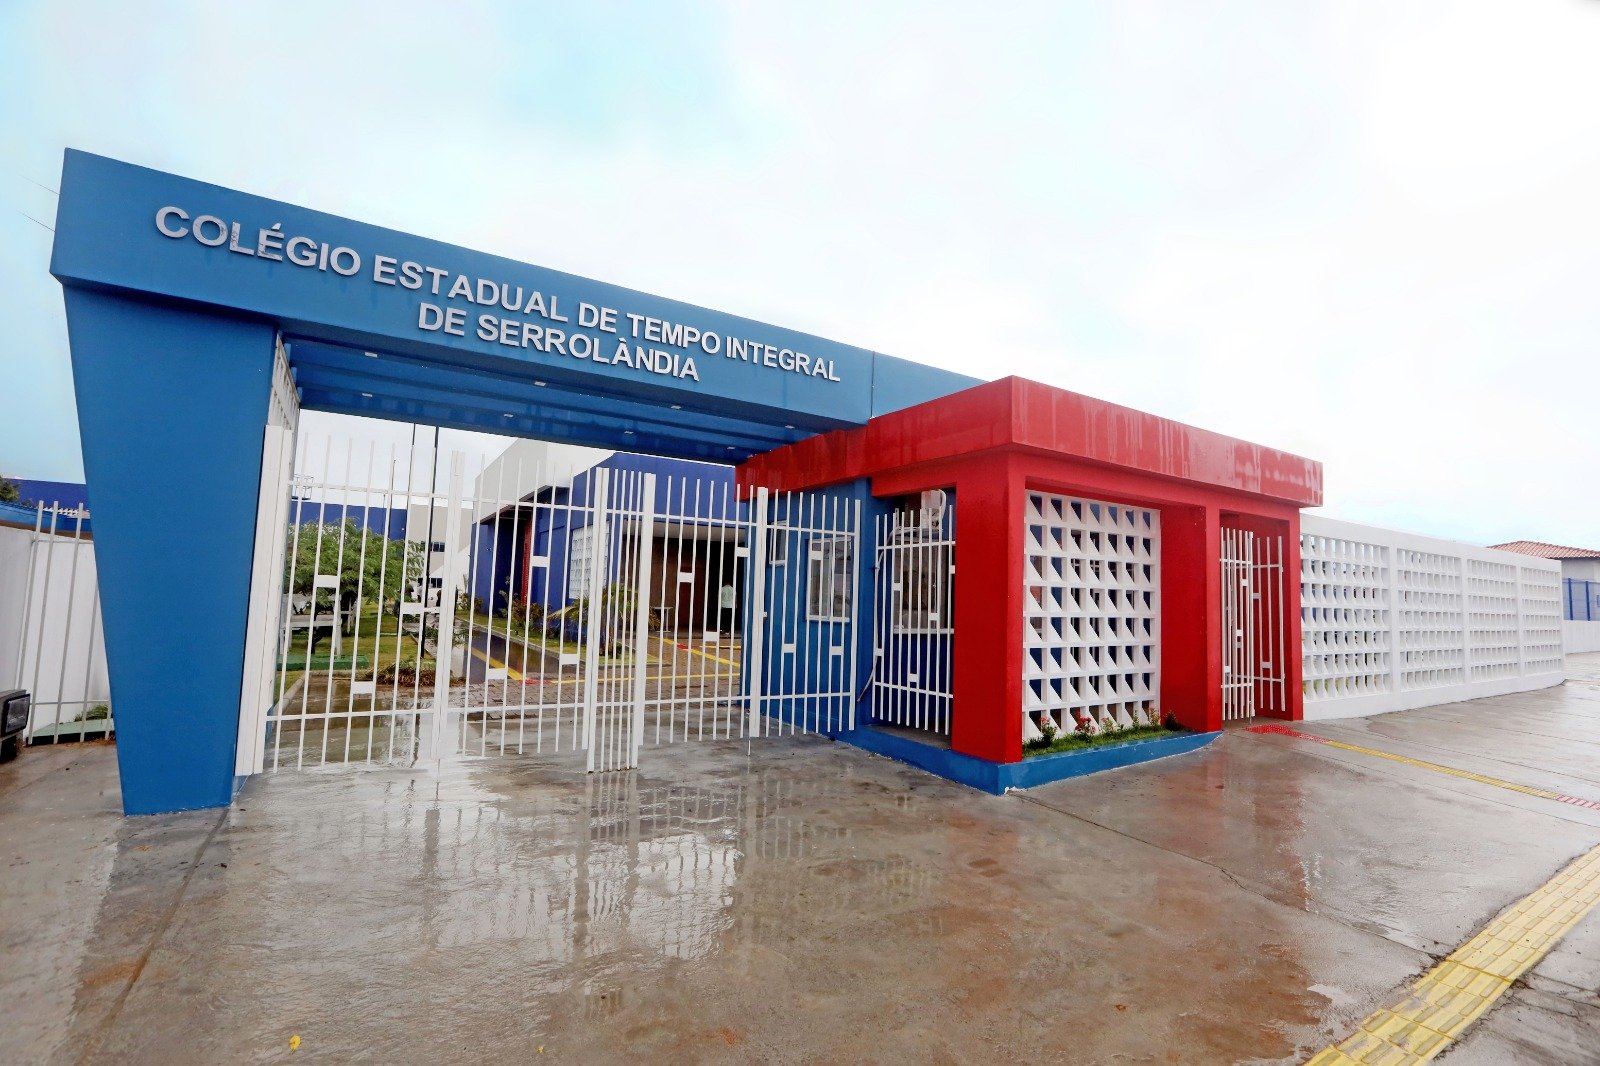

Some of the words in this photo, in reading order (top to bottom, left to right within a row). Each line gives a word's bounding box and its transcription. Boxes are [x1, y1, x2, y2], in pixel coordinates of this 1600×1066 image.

[155, 206, 361, 276] COLÉGIO
[373, 254, 568, 322] ESTADUAL
[578, 302, 618, 334] DE
[626, 312, 721, 355] TEMPO
[726, 336, 841, 383] INTEGRAL
[418, 302, 467, 337] DE
